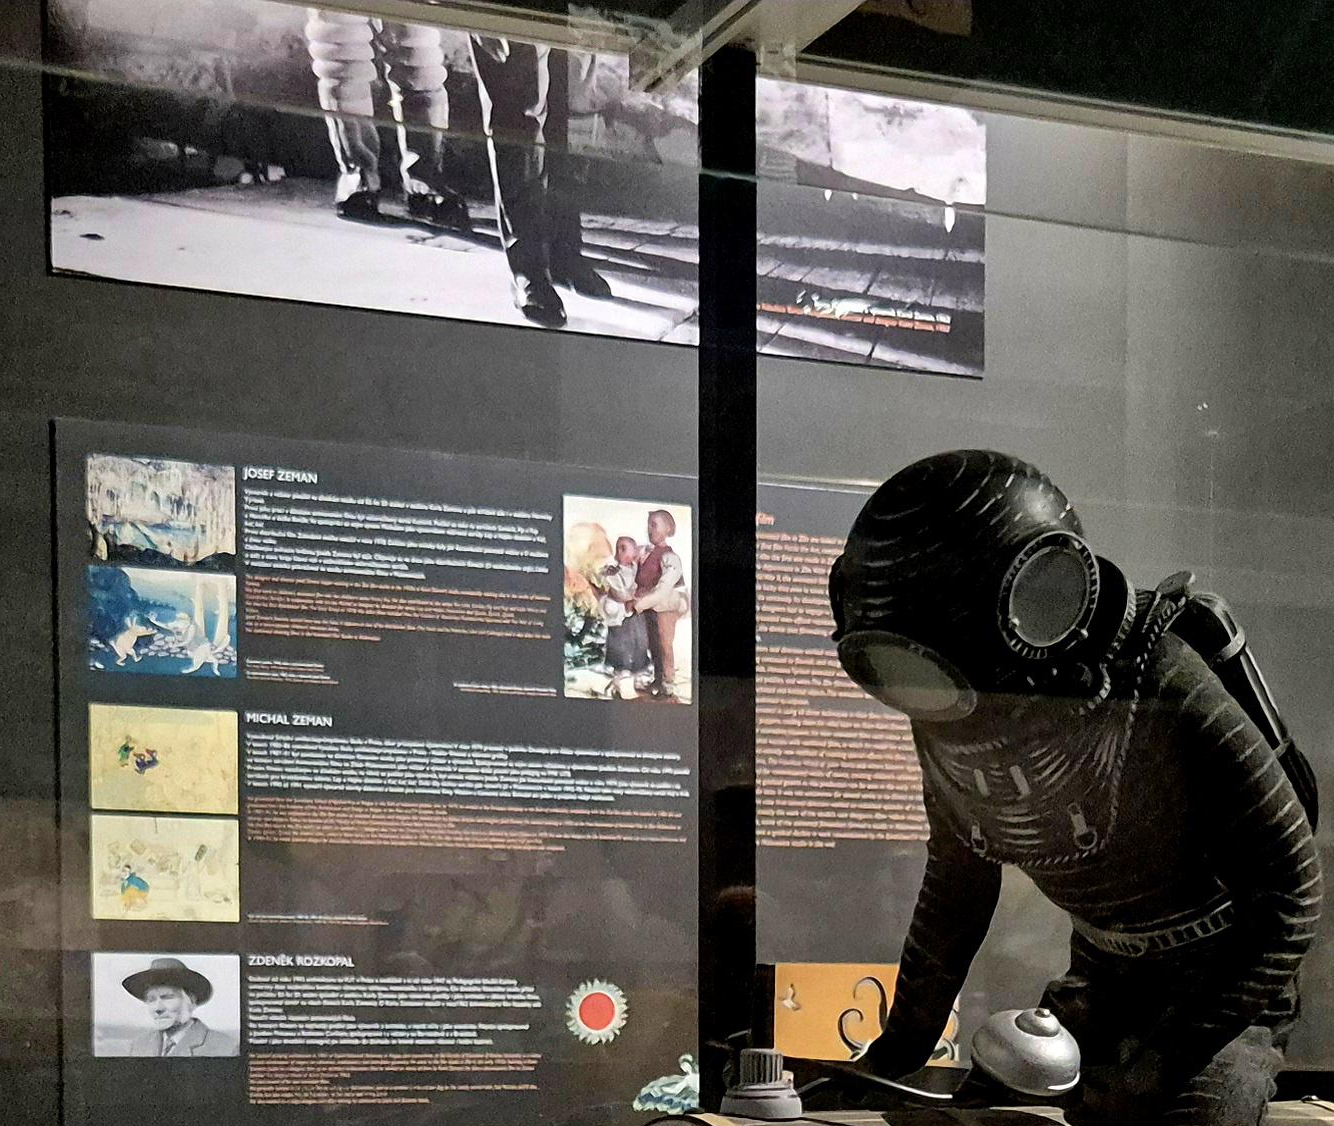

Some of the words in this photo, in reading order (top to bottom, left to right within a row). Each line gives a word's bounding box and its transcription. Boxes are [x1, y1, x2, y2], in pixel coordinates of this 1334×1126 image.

[243, 467, 275, 481] JOSEF
[276, 470, 318, 484] ZEMAN
[245, 713, 290, 725] MICHAL
[292, 715, 333, 727] ZEMAN
[248, 954, 294, 967] ZDENĚK
[295, 956, 355, 968] ROZKOPAL
